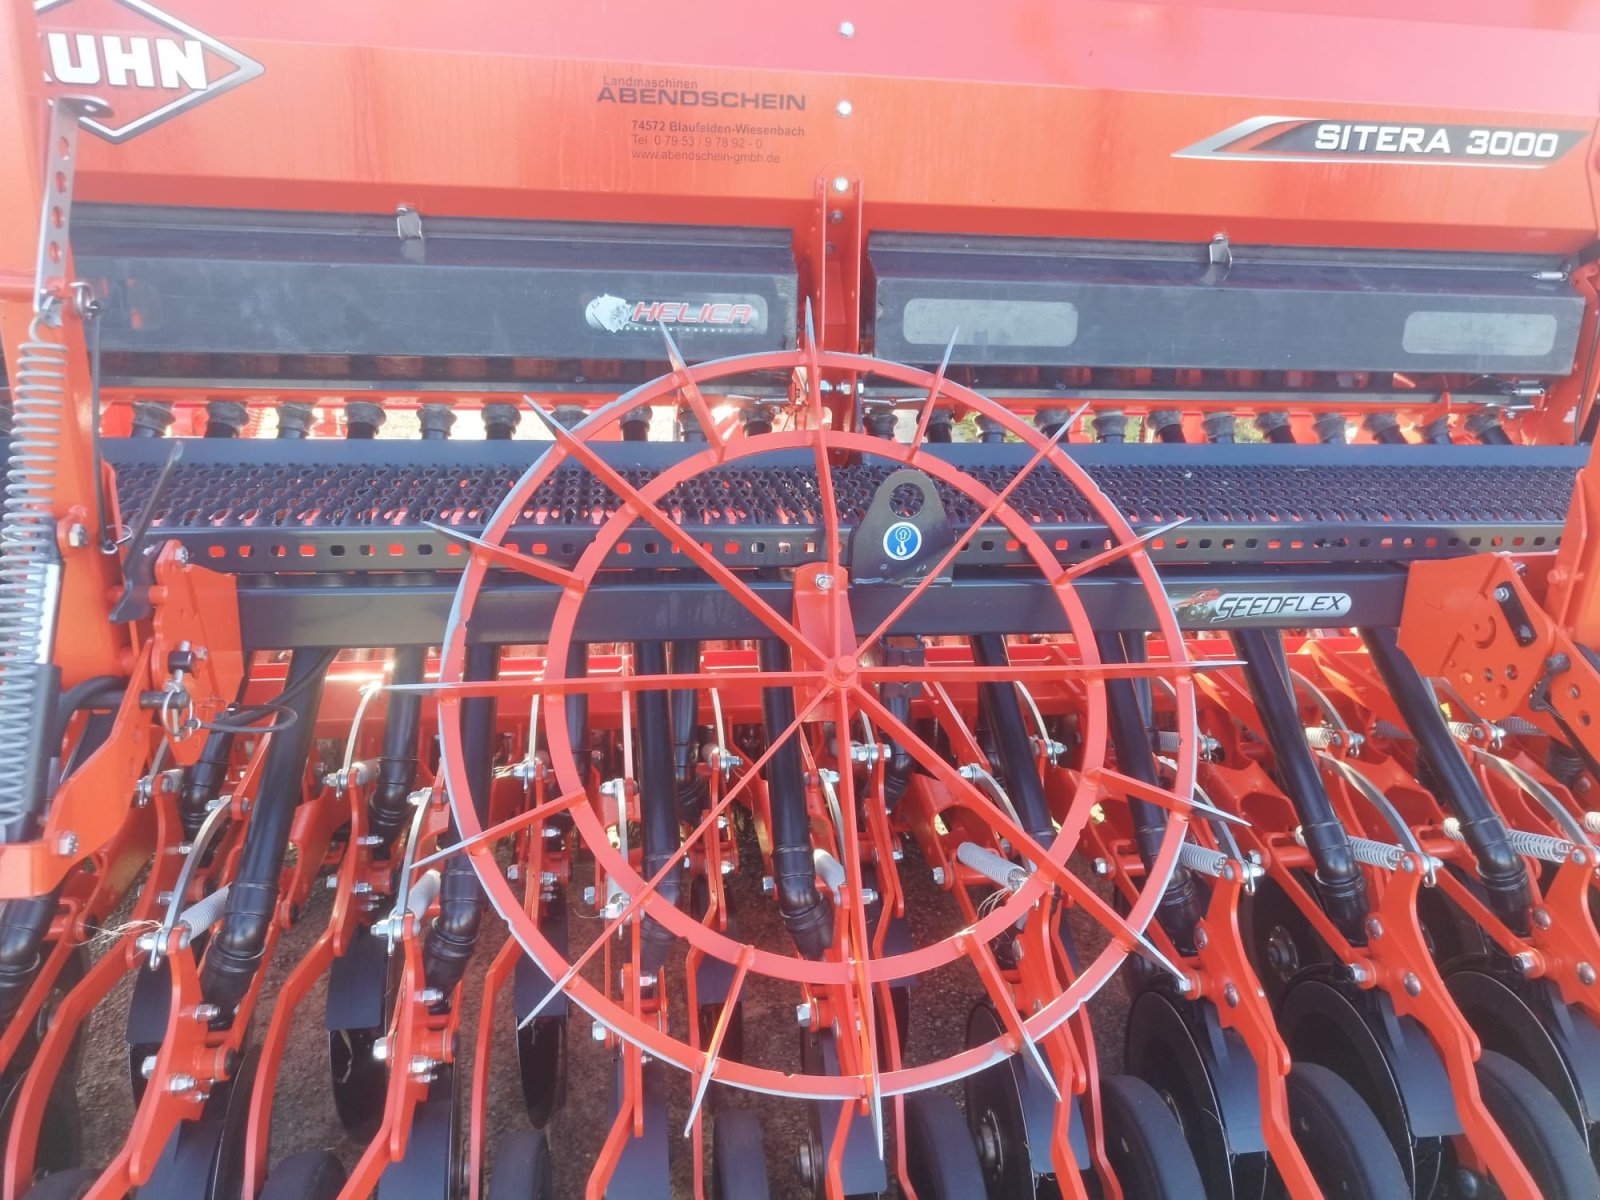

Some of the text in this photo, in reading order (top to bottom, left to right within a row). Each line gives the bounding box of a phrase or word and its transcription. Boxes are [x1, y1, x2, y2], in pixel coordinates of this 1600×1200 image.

[38, 33, 208, 90] UHN
[603, 76, 698, 89] Landmaschinen
[596, 86, 806, 110] ABENDSCHEIN
[632, 119, 805, 136] 74572 Blaufelden-Wiesenbach
[654, 135, 661, 145] 0
[665, 135, 678, 146] 79
[681, 136, 695, 146] 53
[705, 137, 712, 147] 9
[715, 137, 728, 148] 78
[732, 138, 745, 148] 92
[756, 138, 763, 149] 0
[1314, 124, 1559, 157] SITERA 3000
[632, 150, 780, 164] www.abendschein-gmbh.de
[632, 302, 752, 323] HELICA
[1210, 595, 1347, 623] SEEDFLEX
